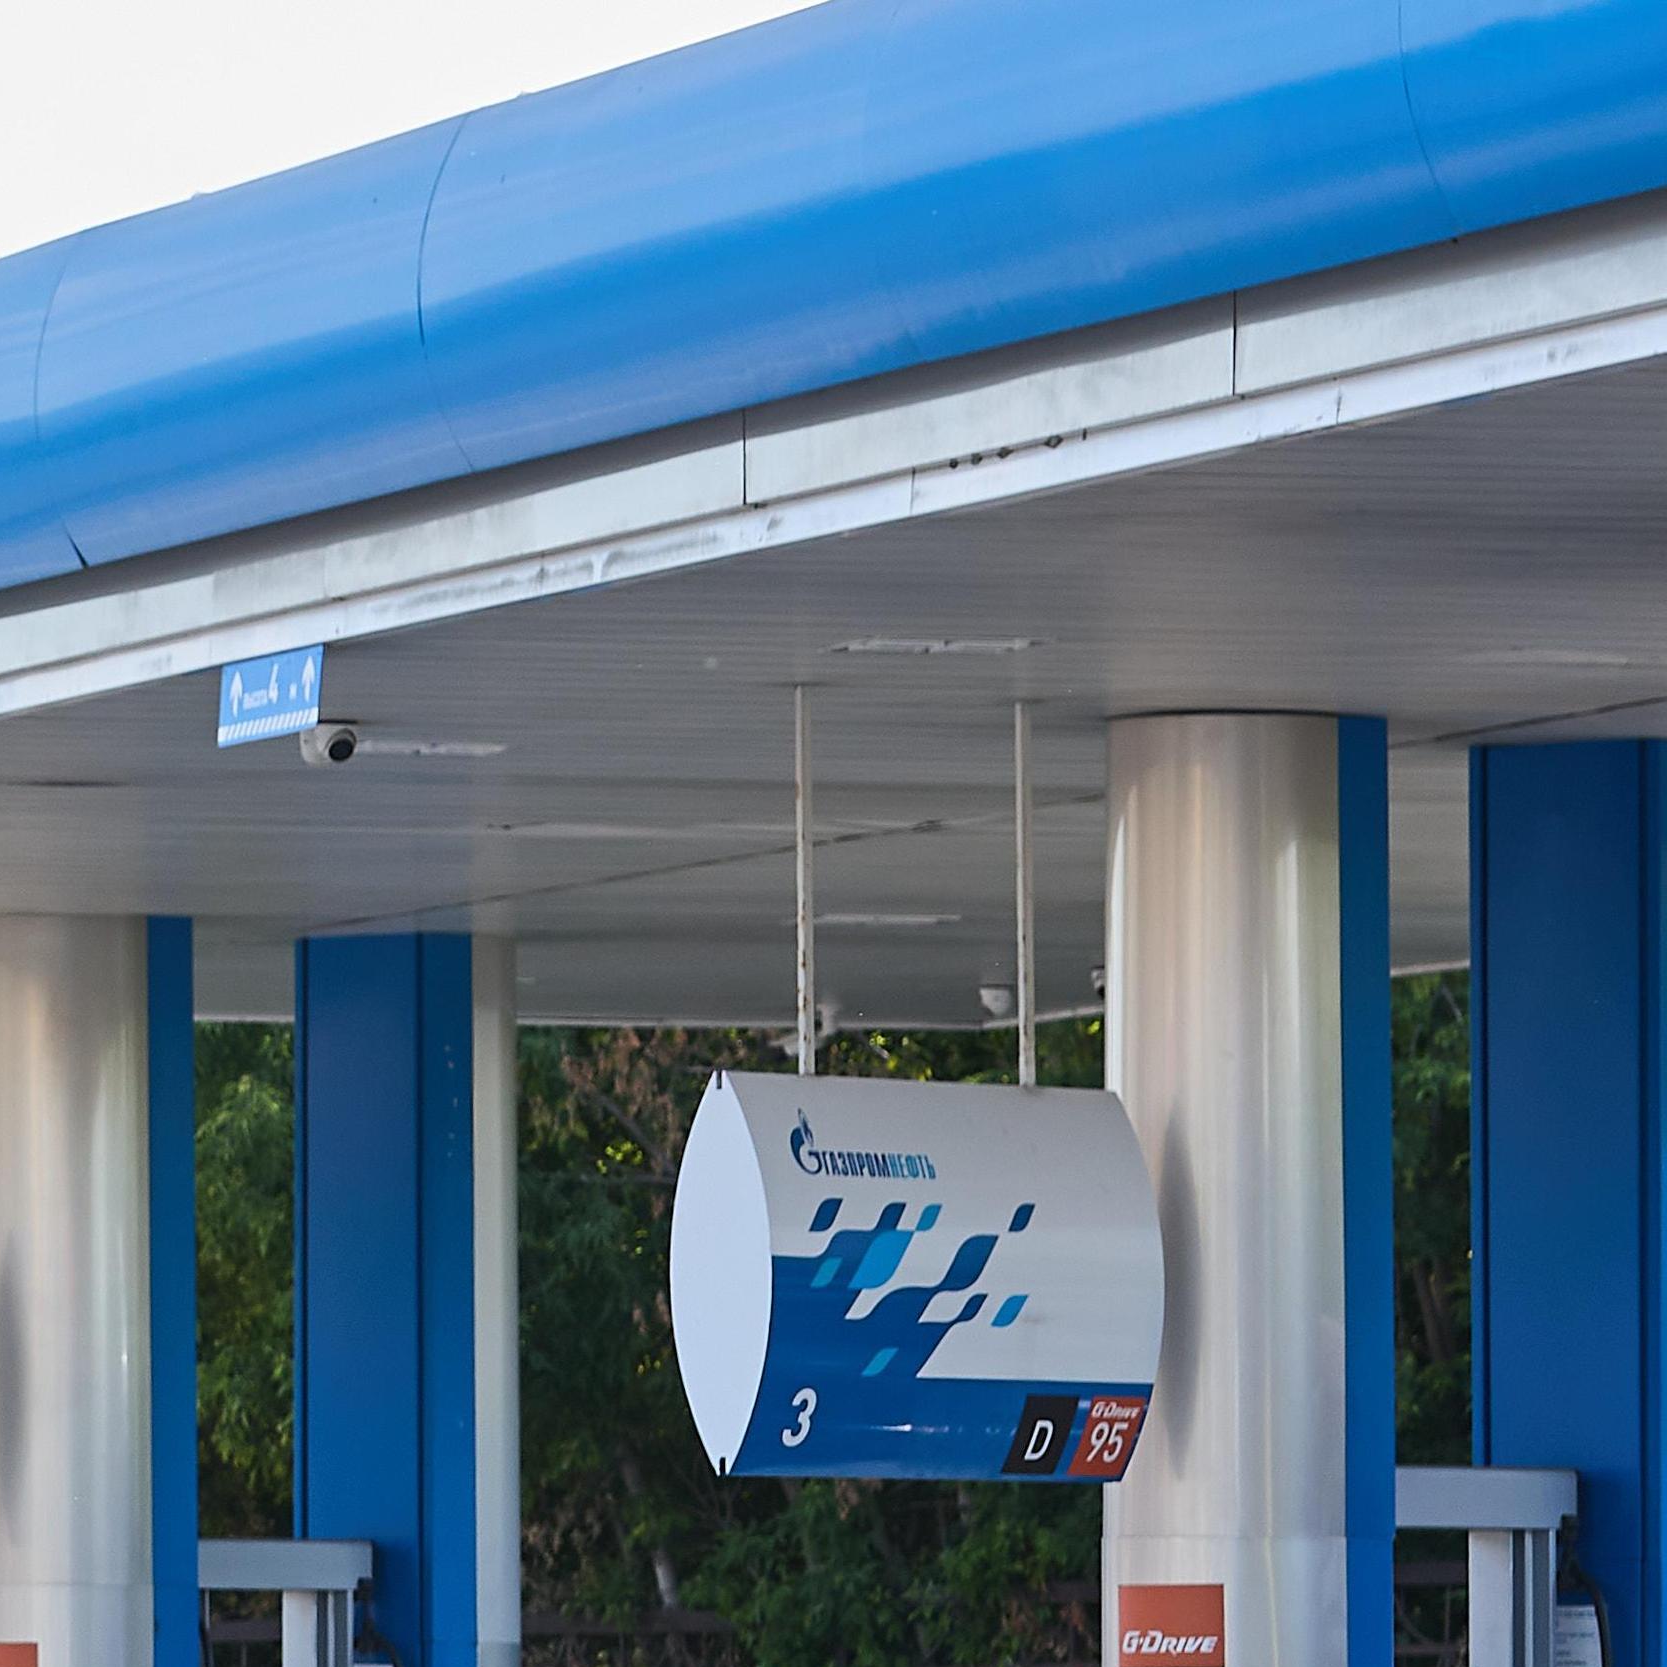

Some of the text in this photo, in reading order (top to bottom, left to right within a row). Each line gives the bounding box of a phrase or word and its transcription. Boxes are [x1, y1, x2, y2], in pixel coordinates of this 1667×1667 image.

[820, 1150, 937, 1181] ГАЗПРОМНЕФТЬ
[781, 1388, 817, 1448] 3
[1024, 1419, 1054, 1462] D
[1086, 1421, 1129, 1463] 95
